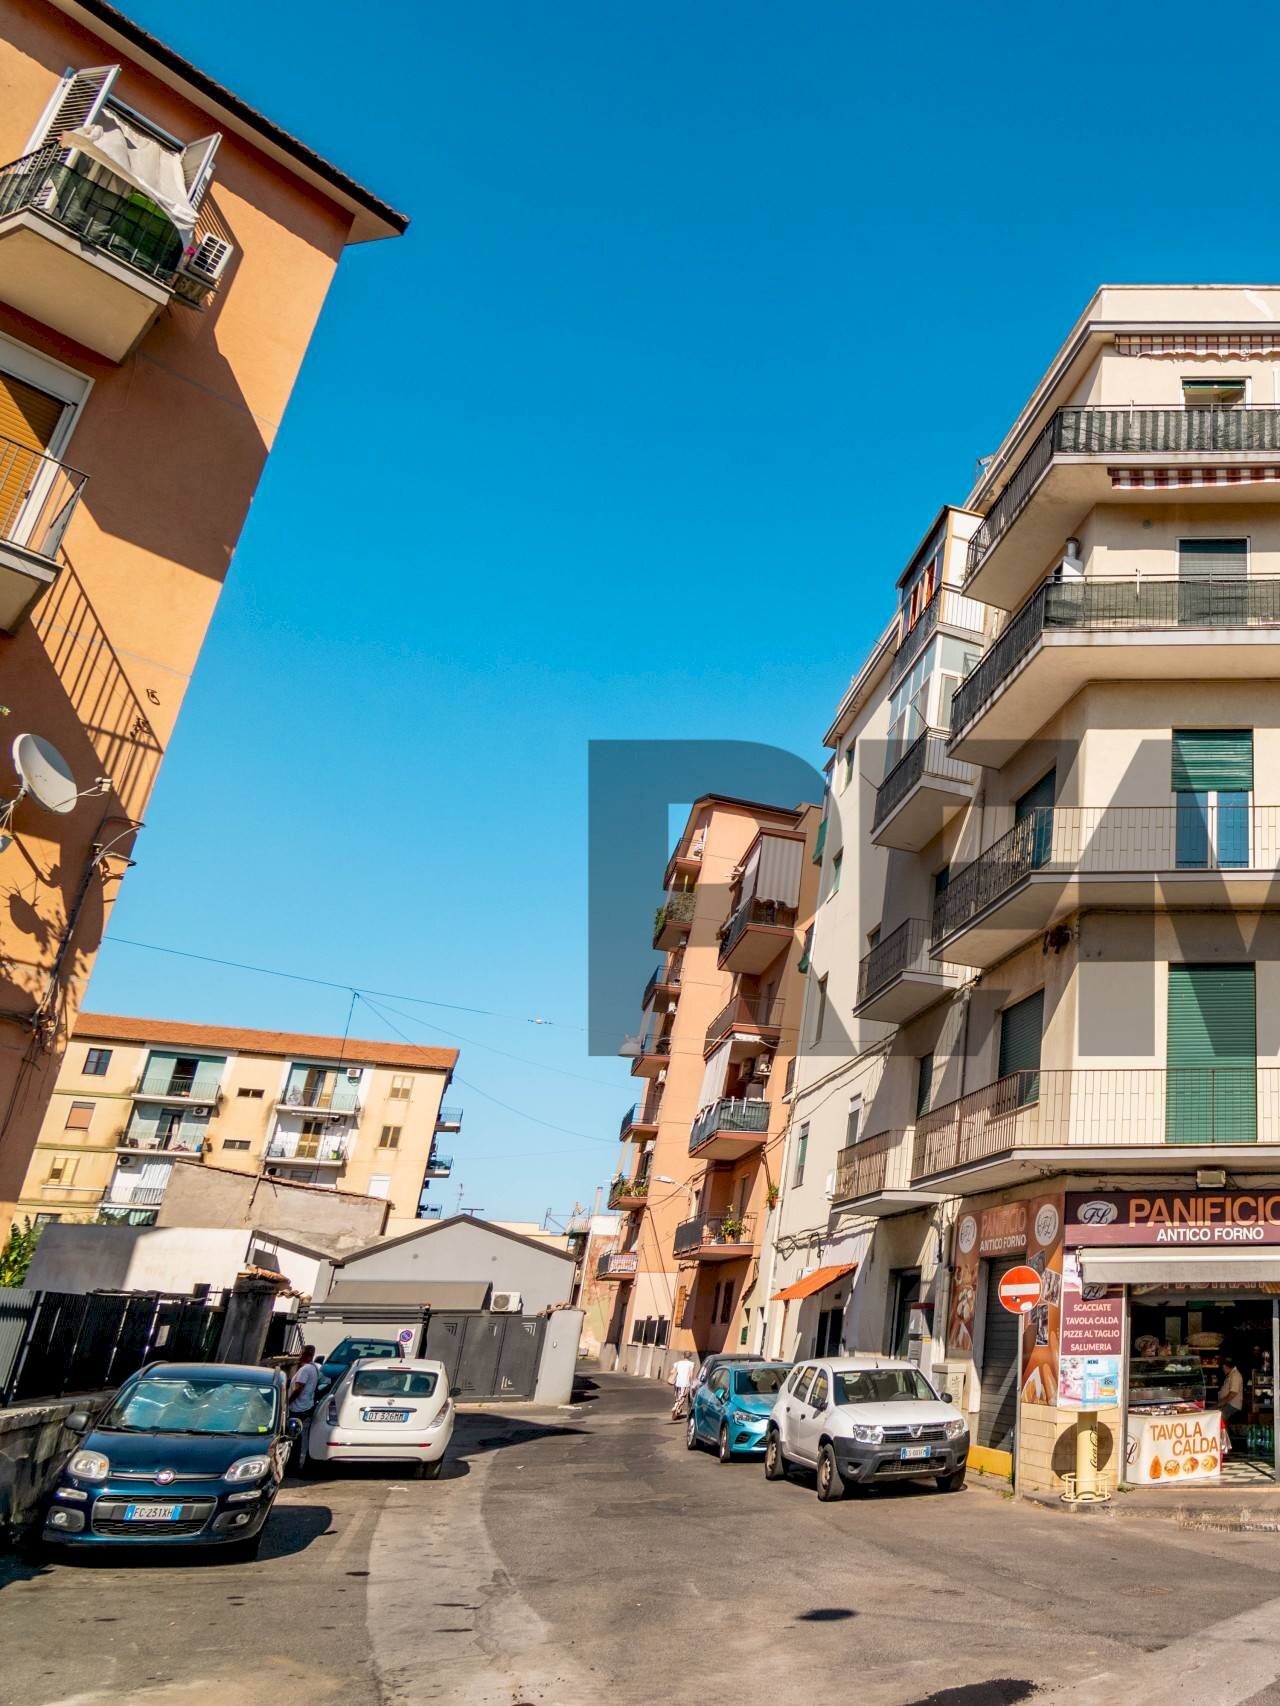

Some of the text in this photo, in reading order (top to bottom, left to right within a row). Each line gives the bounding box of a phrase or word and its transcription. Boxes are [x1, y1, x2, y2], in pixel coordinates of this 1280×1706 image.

[981, 1208, 1027, 1237] PANIFICIO
[1156, 1227, 1265, 1241] ANTICO FORNO
[980, 1234, 1027, 1252] ANTICO FORNO
[1073, 1303, 1112, 1312] SCACCIATE
[1065, 1316, 1119, 1325] TAVOLA CALDA
[1063, 1329, 1120, 1338] PIZZE AL TAGLIO
[1070, 1343, 1112, 1352] SALUMERIA
[1149, 1421, 1202, 1441] TAVOLA
[1172, 1436, 1219, 1456] CALDA
